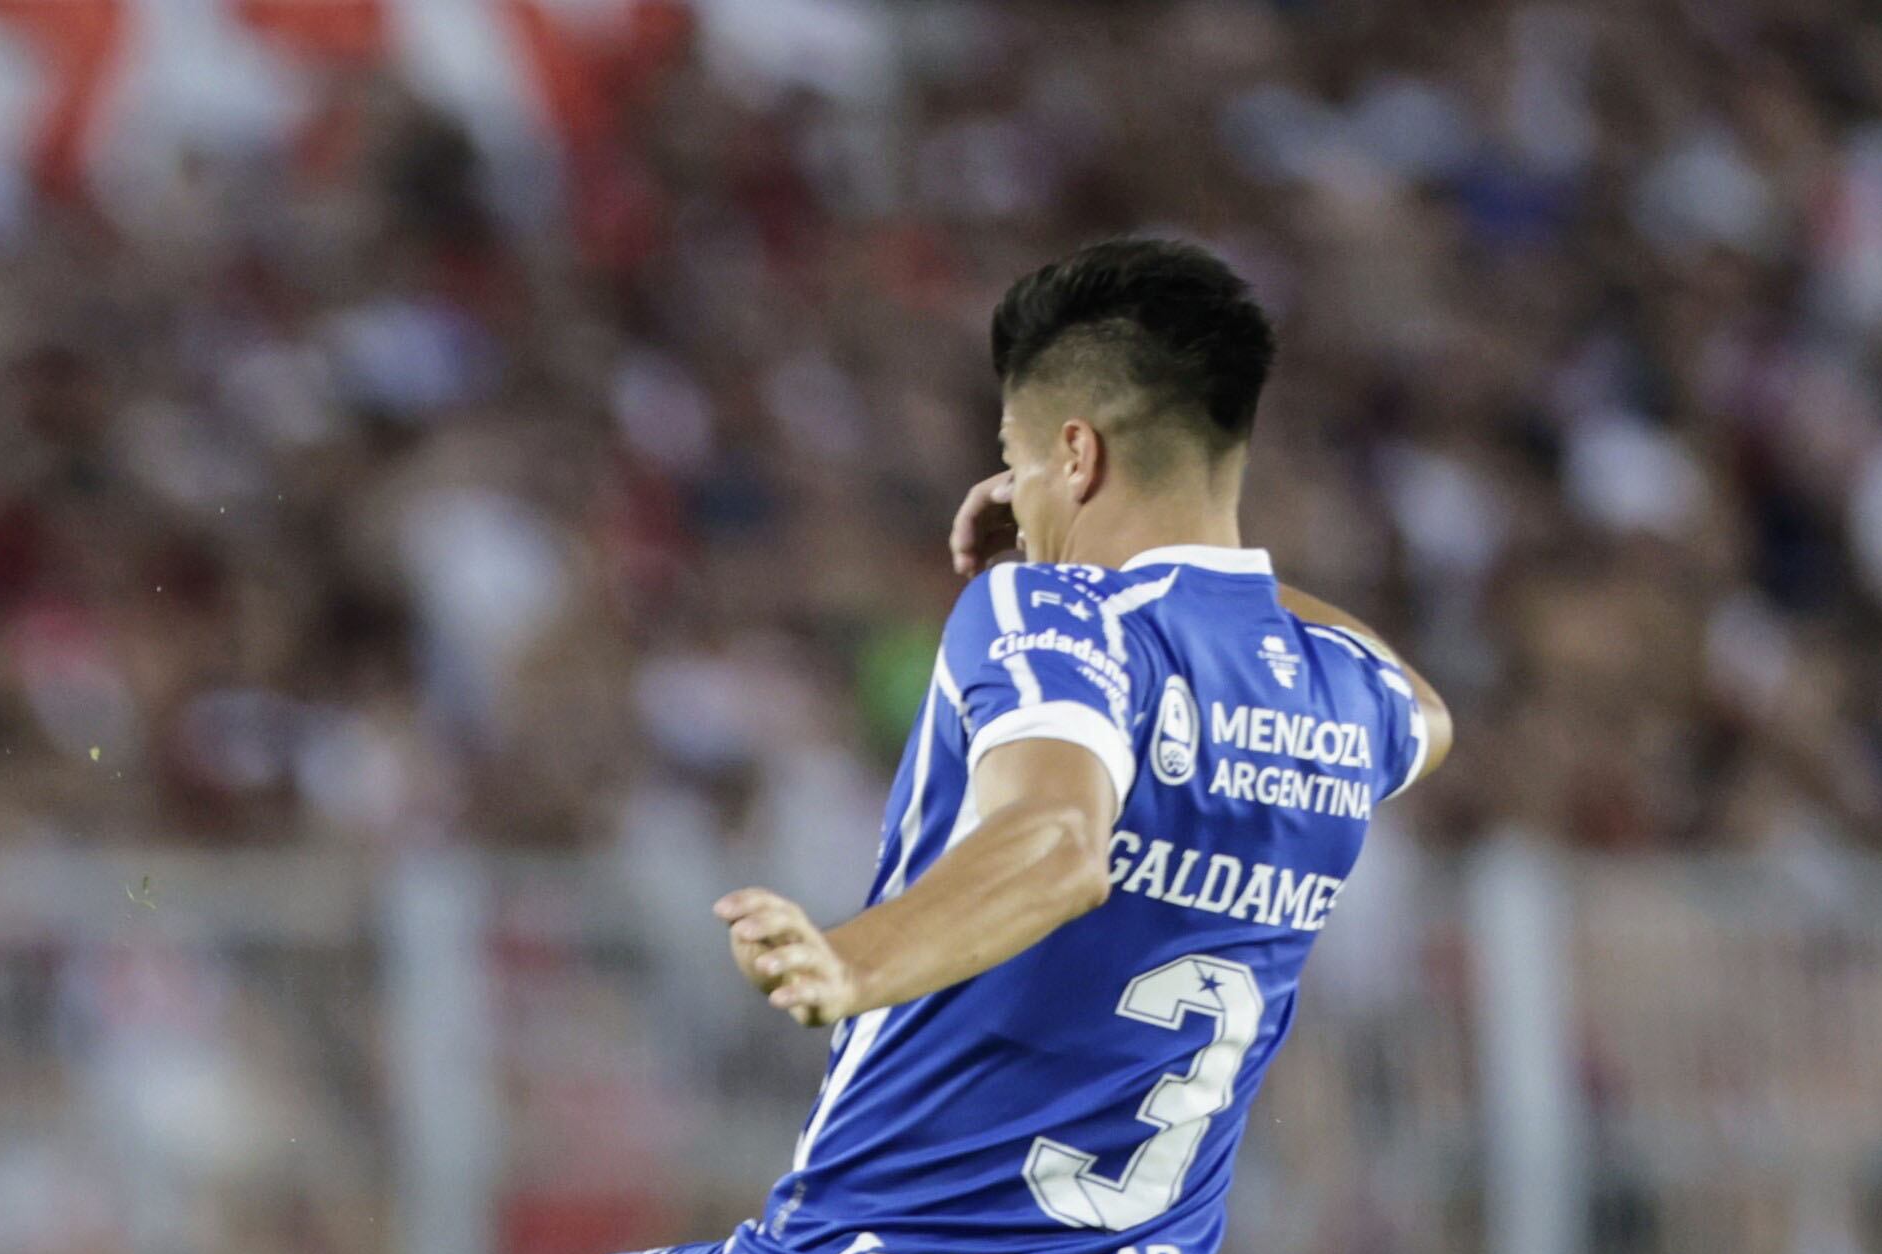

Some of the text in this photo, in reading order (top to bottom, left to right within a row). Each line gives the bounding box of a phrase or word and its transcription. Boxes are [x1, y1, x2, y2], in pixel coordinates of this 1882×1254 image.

[1211, 701, 1372, 769] MENDOZA
[1208, 757, 1371, 820] ARGENTINA
[1023, 954, 1264, 1232] 3
